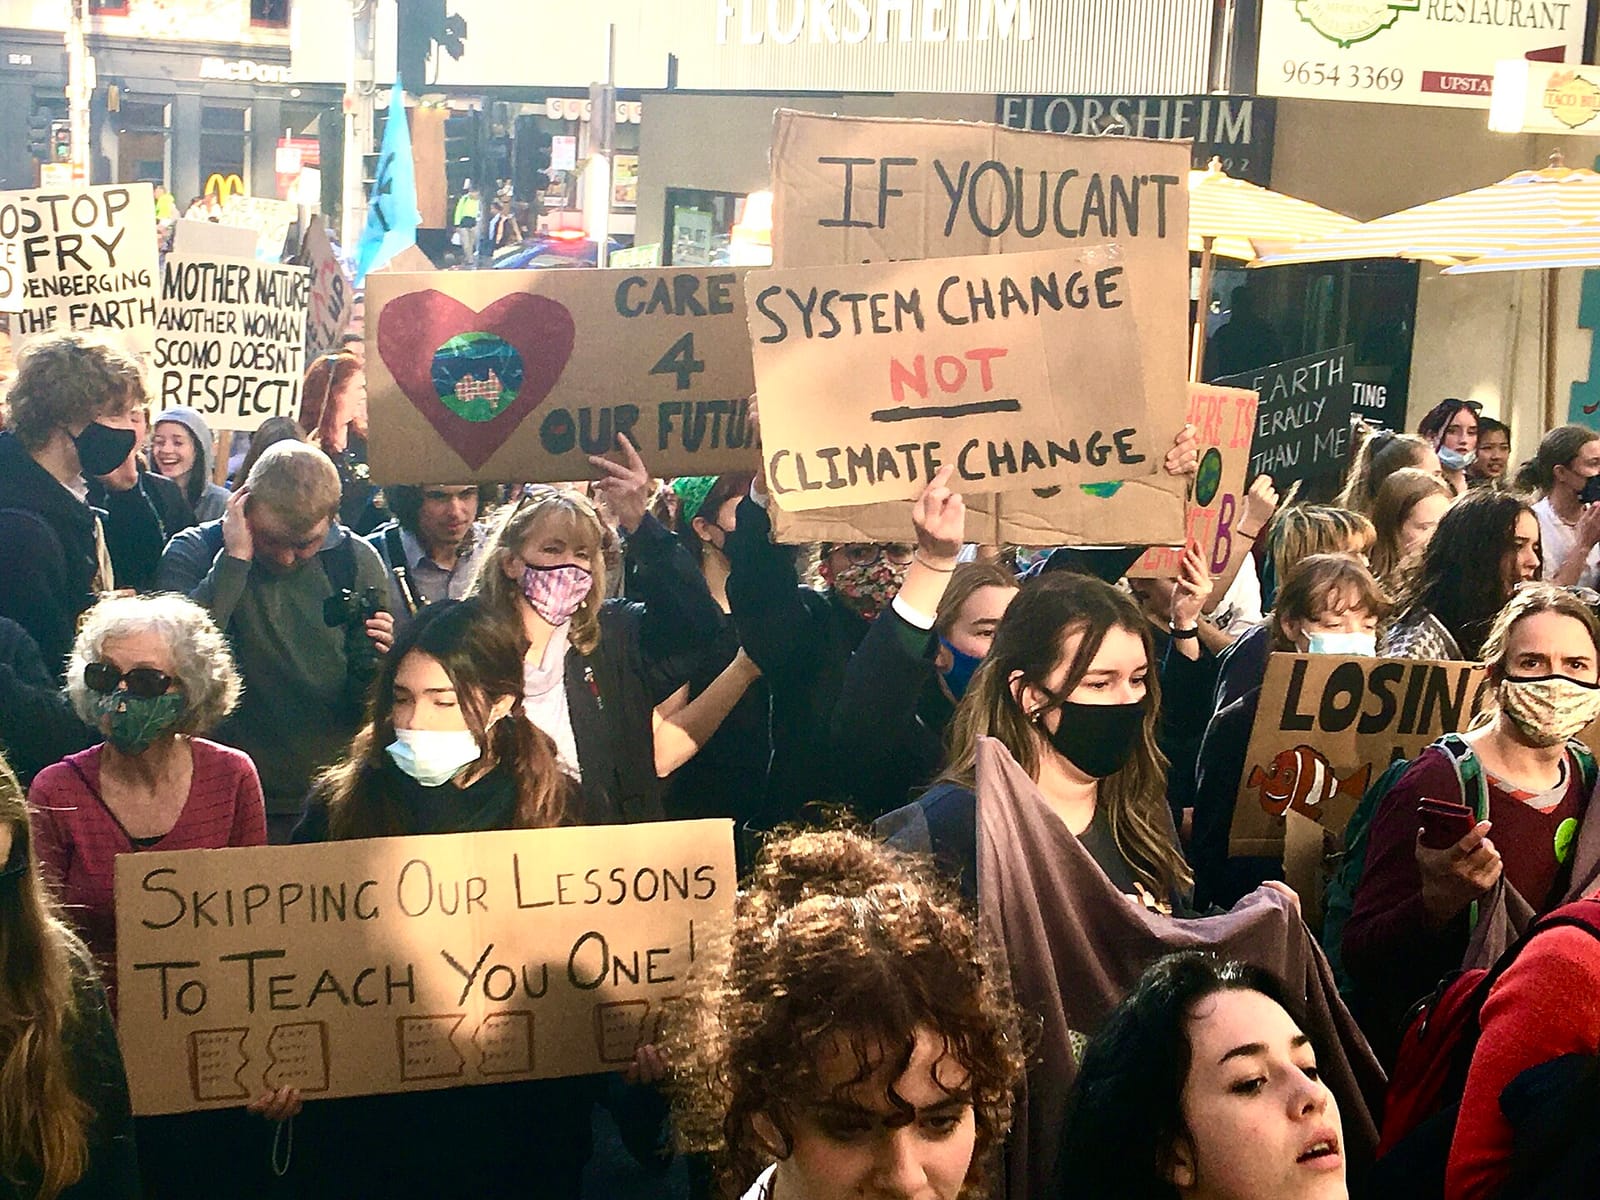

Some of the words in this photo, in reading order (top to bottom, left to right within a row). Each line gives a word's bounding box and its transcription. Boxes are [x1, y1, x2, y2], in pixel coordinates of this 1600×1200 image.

[1283, 60, 1340, 86] 9654
[1348, 65, 1404, 91] 3369
[1002, 97, 1254, 144] FLORSHEIM
[818, 157, 918, 229] IF
[24, 226, 126, 273] FRY
[162, 261, 250, 305] MOTHER
[255, 267, 311, 312] NATURE
[615, 273, 736, 318] CARE
[755, 285, 926, 343] SYSTEM
[937, 266, 1124, 325] CHANGE
[157, 307, 237, 335] ANOTHER
[242, 309, 301, 343] WOMAN
[153, 337, 222, 369] SCOMO
[648, 332, 705, 390] 4
[889, 347, 1008, 401] NOT
[161, 370, 298, 418] RESPECT!
[1253, 355, 1344, 405] EARTH
[538, 403, 643, 456] OUR
[1313, 427, 1347, 462] ME
[769, 440, 942, 494] CLIMATE
[956, 428, 1147, 481] CHANGE
[140, 866, 380, 930] SKIPPING
[397, 858, 489, 918] OUR
[513, 852, 718, 910] LESSONS
[133, 960, 208, 1020] TO
[219, 948, 416, 1014] TEACH
[440, 943, 550, 1006] YOU
